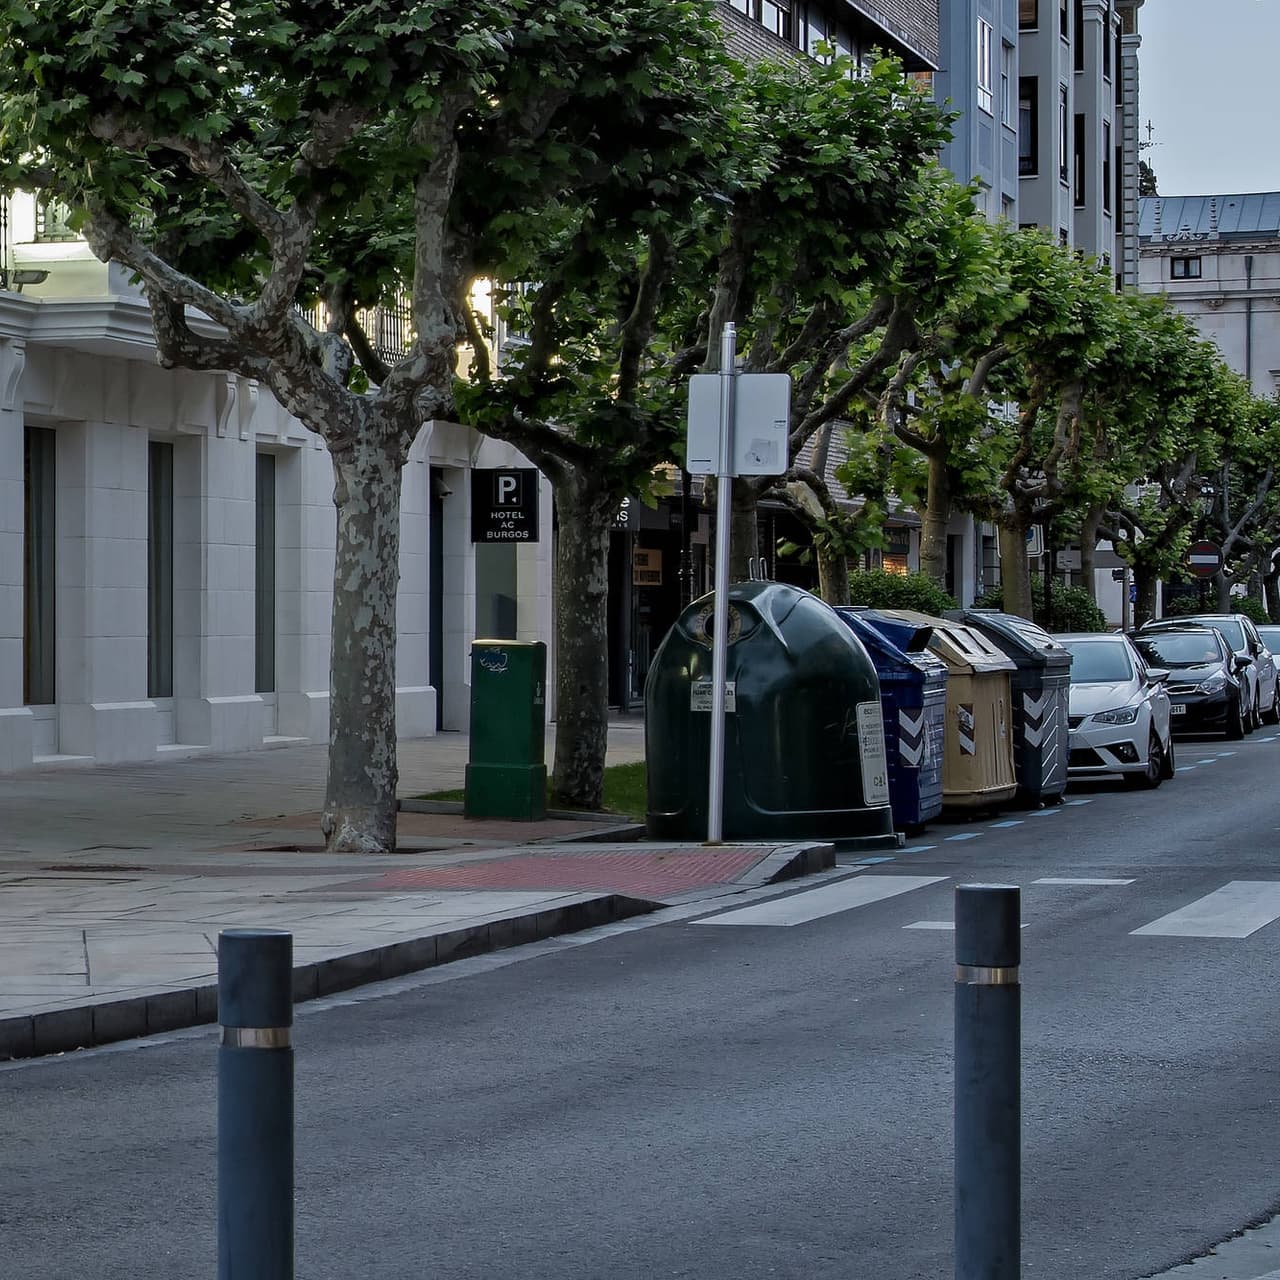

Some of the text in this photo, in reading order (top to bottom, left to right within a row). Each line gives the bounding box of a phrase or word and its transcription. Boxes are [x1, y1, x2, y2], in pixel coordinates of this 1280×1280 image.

[498, 476, 517, 503] P
[490, 511, 525, 519] HOTEL
[500, 521, 515, 529] AC
[486, 530, 529, 538] BURGOS
